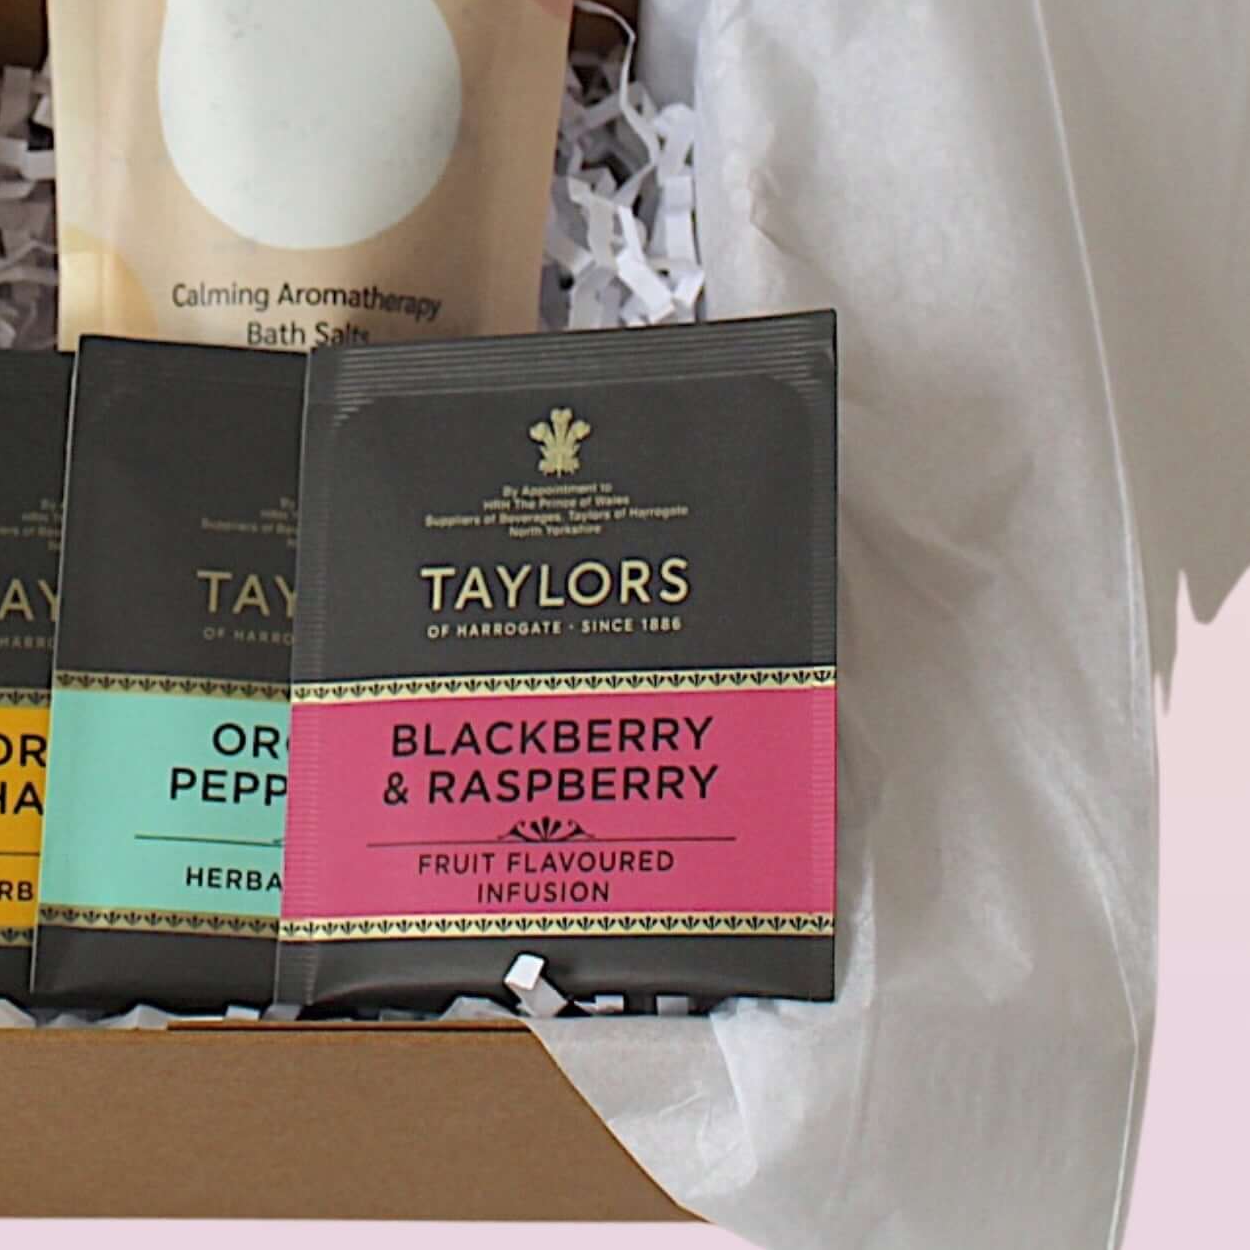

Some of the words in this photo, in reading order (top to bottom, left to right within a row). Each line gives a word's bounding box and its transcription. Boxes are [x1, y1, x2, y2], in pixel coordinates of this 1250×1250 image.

[171, 282, 270, 312] Calming
[277, 282, 443, 322] Aromatherapy
[246, 321, 306, 346] Bath
[420, 557, 690, 612] TAYLORS
[427, 625, 450, 639] OF
[456, 620, 562, 637] HARROGATE
[581, 618, 633, 634] SINCE
[641, 616, 682, 632] 1886
[212, 722, 290, 760] OR
[391, 715, 714, 758] BLACKBERRY
[169, 766, 288, 807] PEPP
[383, 771, 409, 805] &
[428, 764, 719, 804] RASPBERRY
[186, 865, 283, 892] HERBA
[418, 852, 496, 875] FRUIT
[506, 850, 675, 874] FLAVOURED
[477, 881, 610, 903] INFUSION
